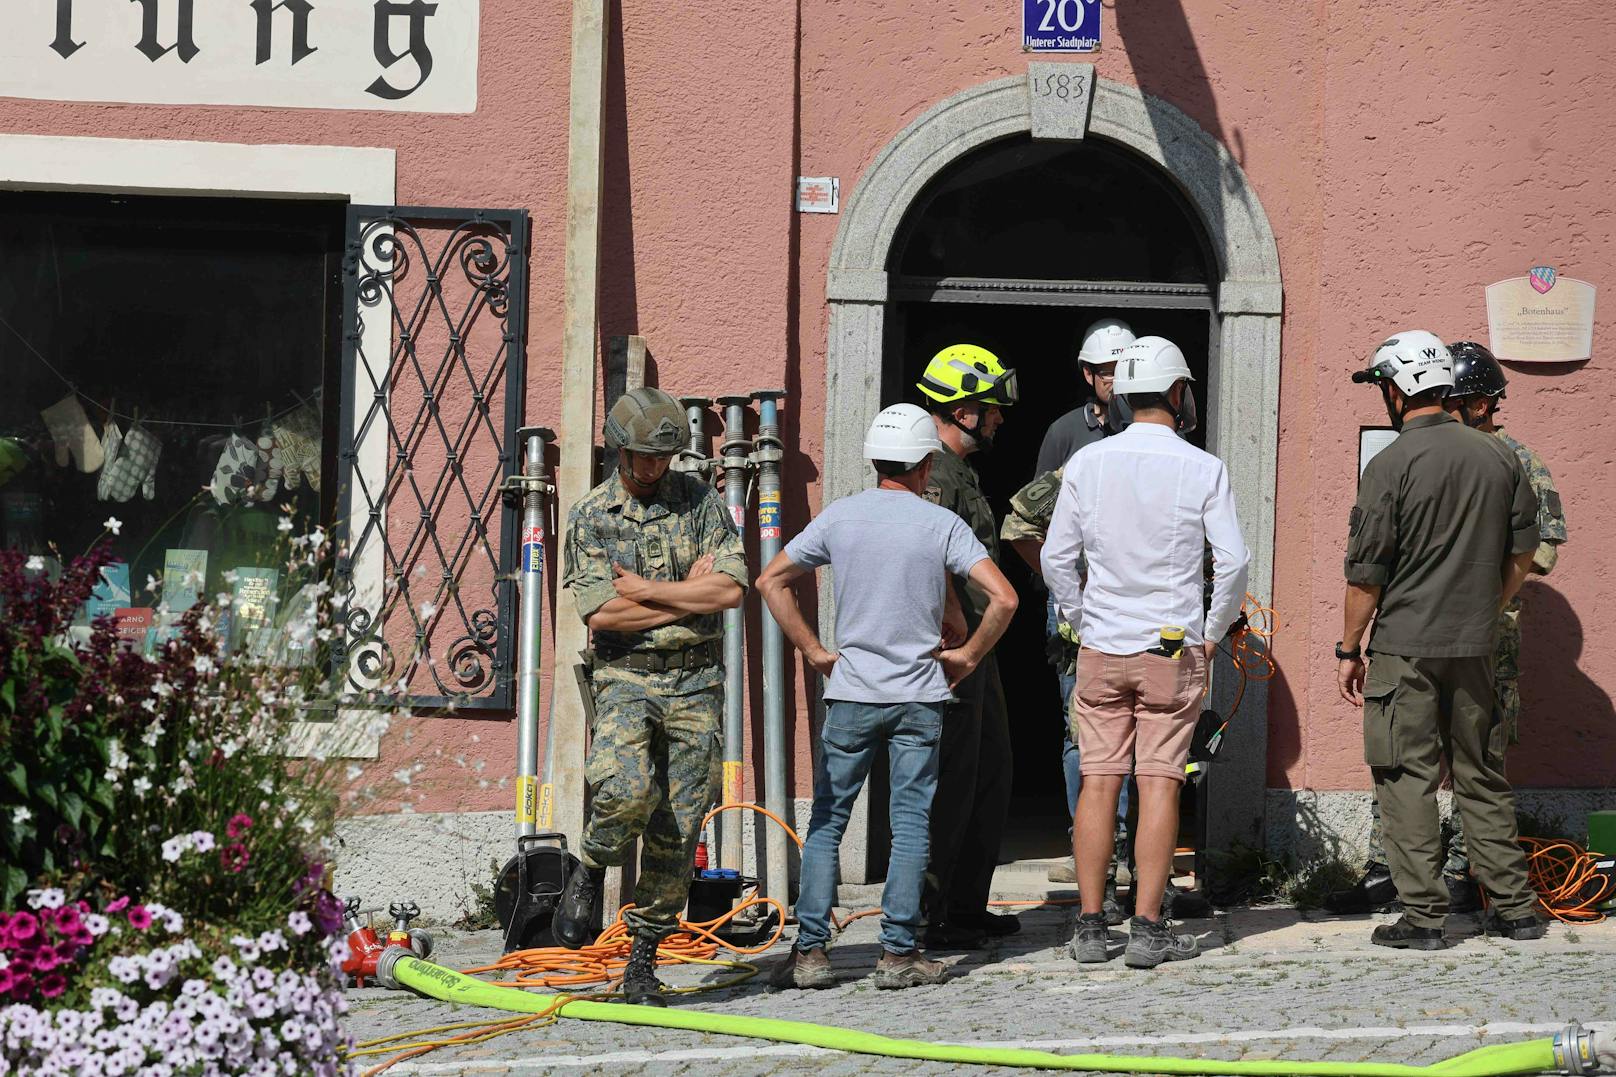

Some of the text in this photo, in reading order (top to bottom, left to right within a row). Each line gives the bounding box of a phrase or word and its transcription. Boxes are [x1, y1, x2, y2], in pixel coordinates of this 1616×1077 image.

[1026, 35, 1097, 50] Unterer Stadtplatz
[1034, 73, 1085, 99] 1583
[1422, 347, 1436, 360] W
[531, 548, 540, 570] Eurex
[525, 783, 534, 816] doka
